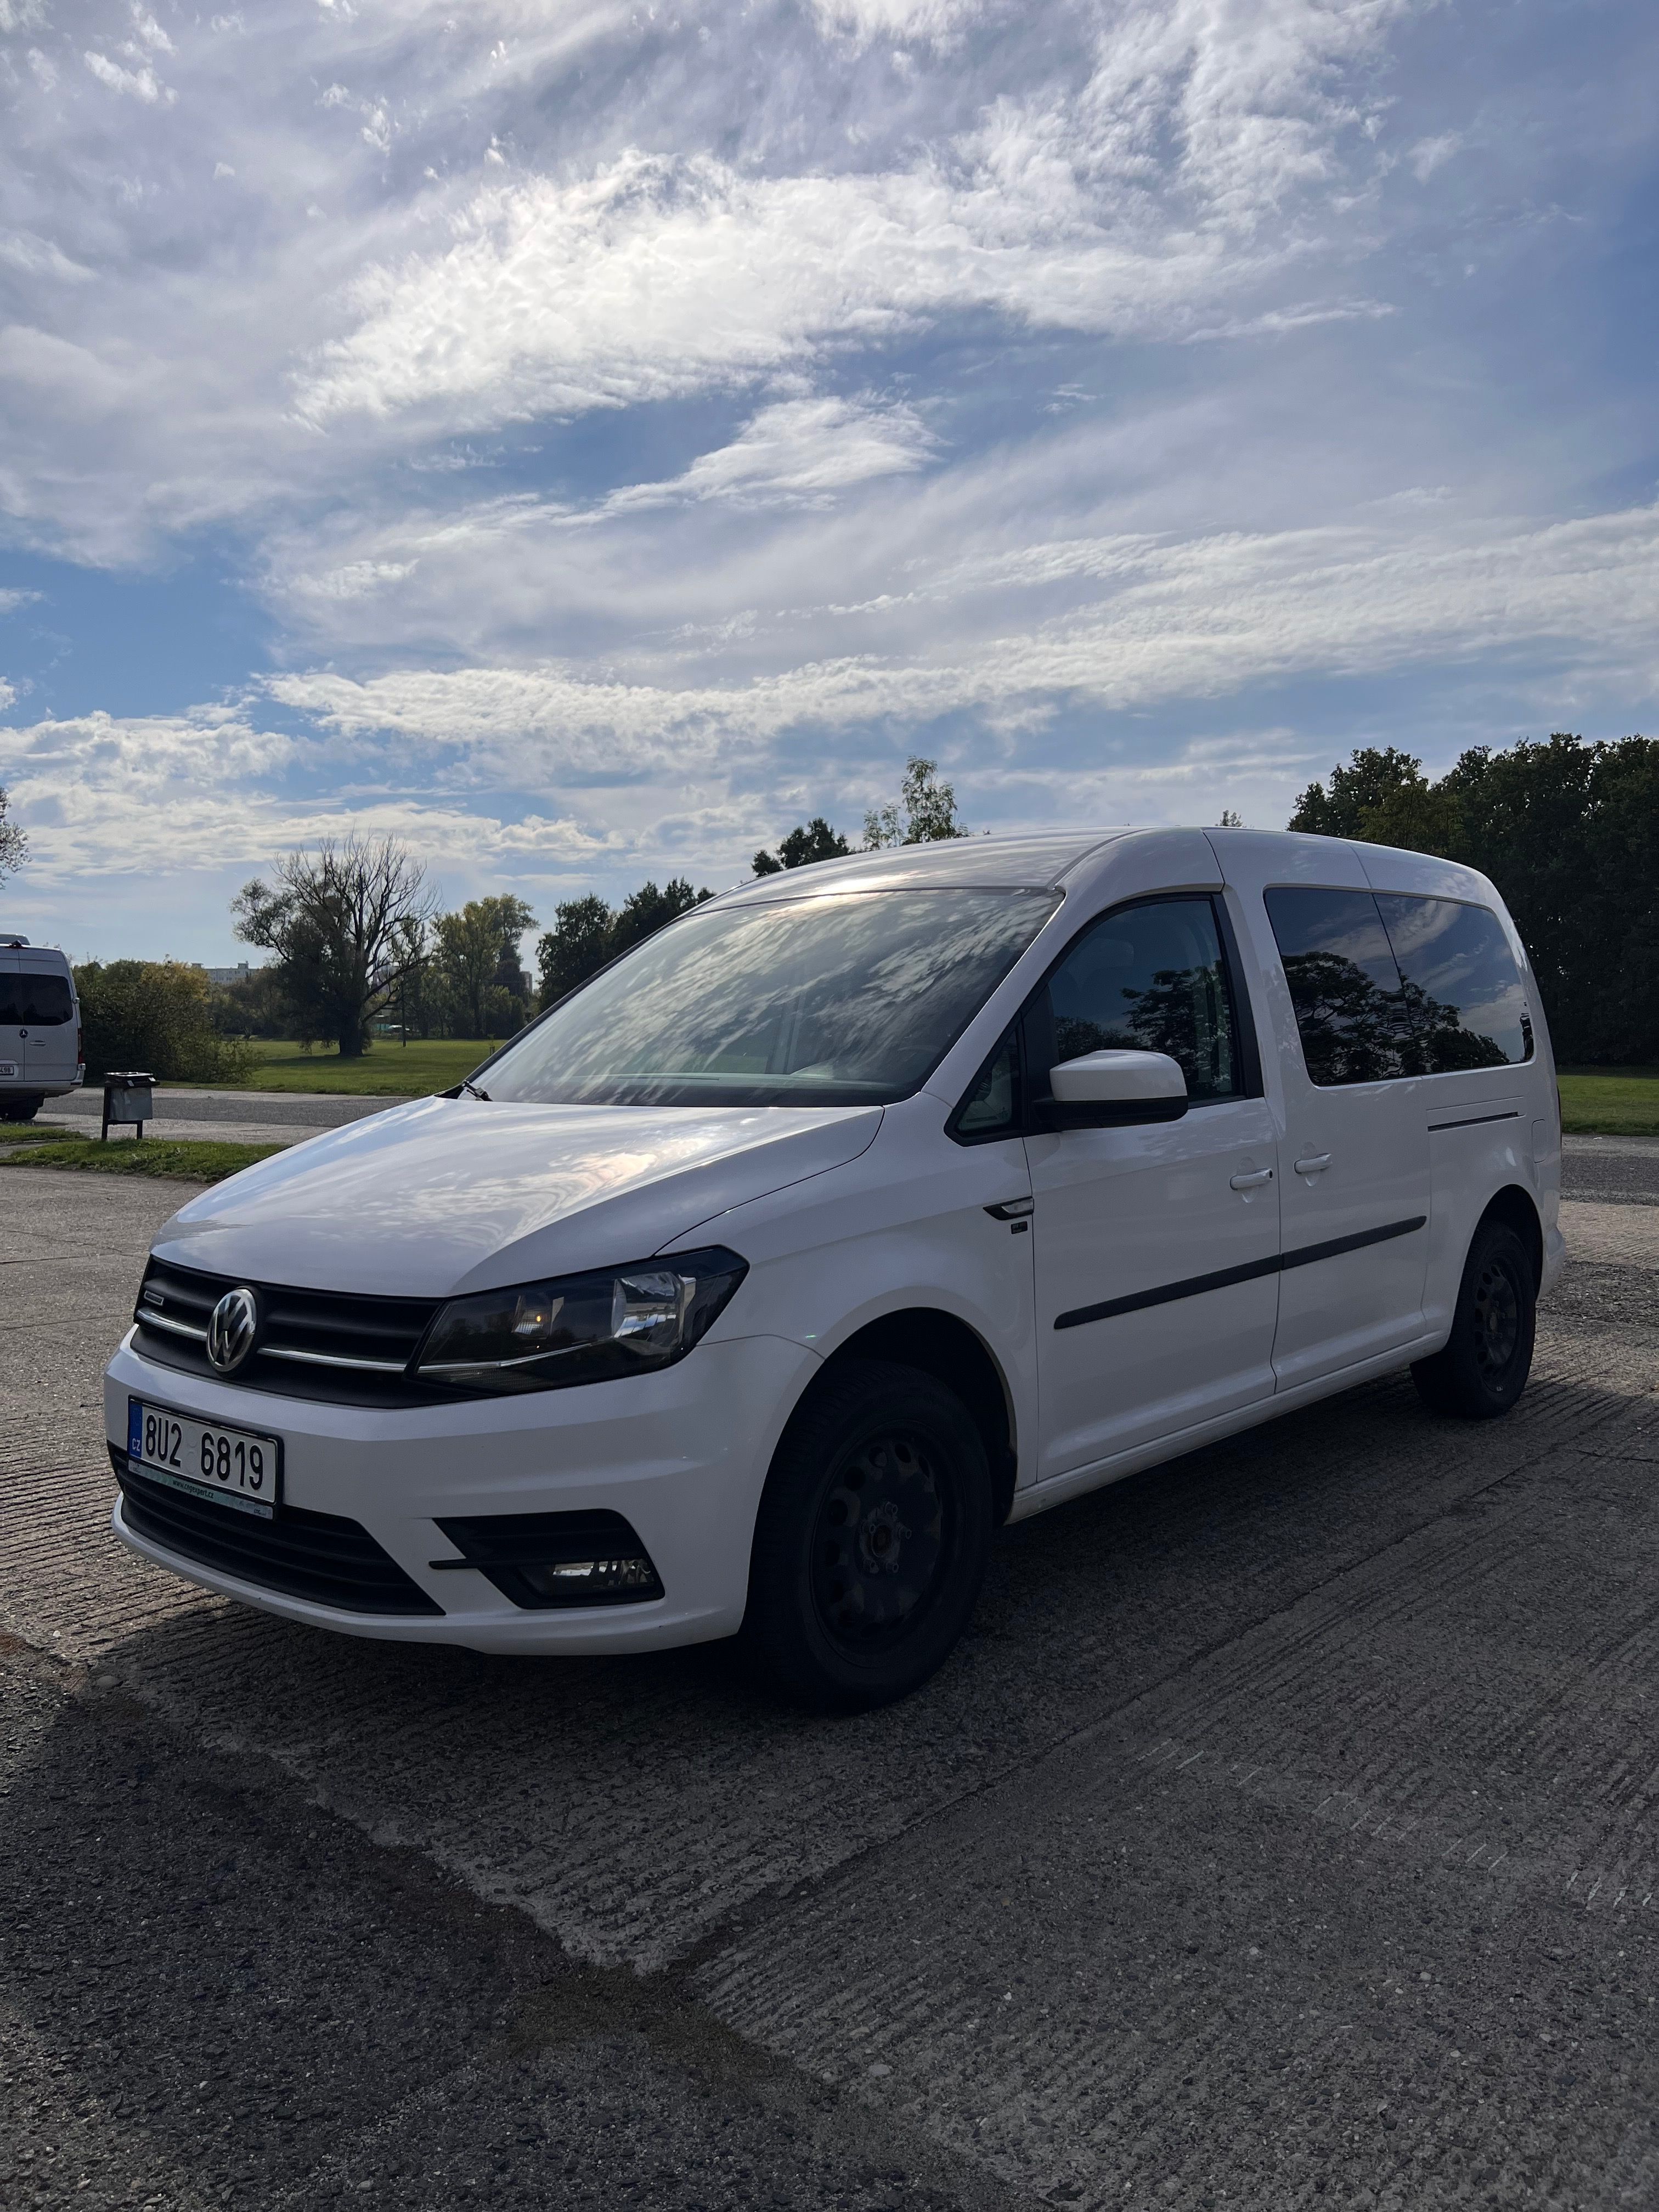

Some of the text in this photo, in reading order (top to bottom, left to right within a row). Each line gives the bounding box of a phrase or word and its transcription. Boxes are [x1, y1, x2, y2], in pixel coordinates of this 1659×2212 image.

[132, 1438, 140, 1452] CZ
[146, 1414, 263, 1490] 8U2 6819
